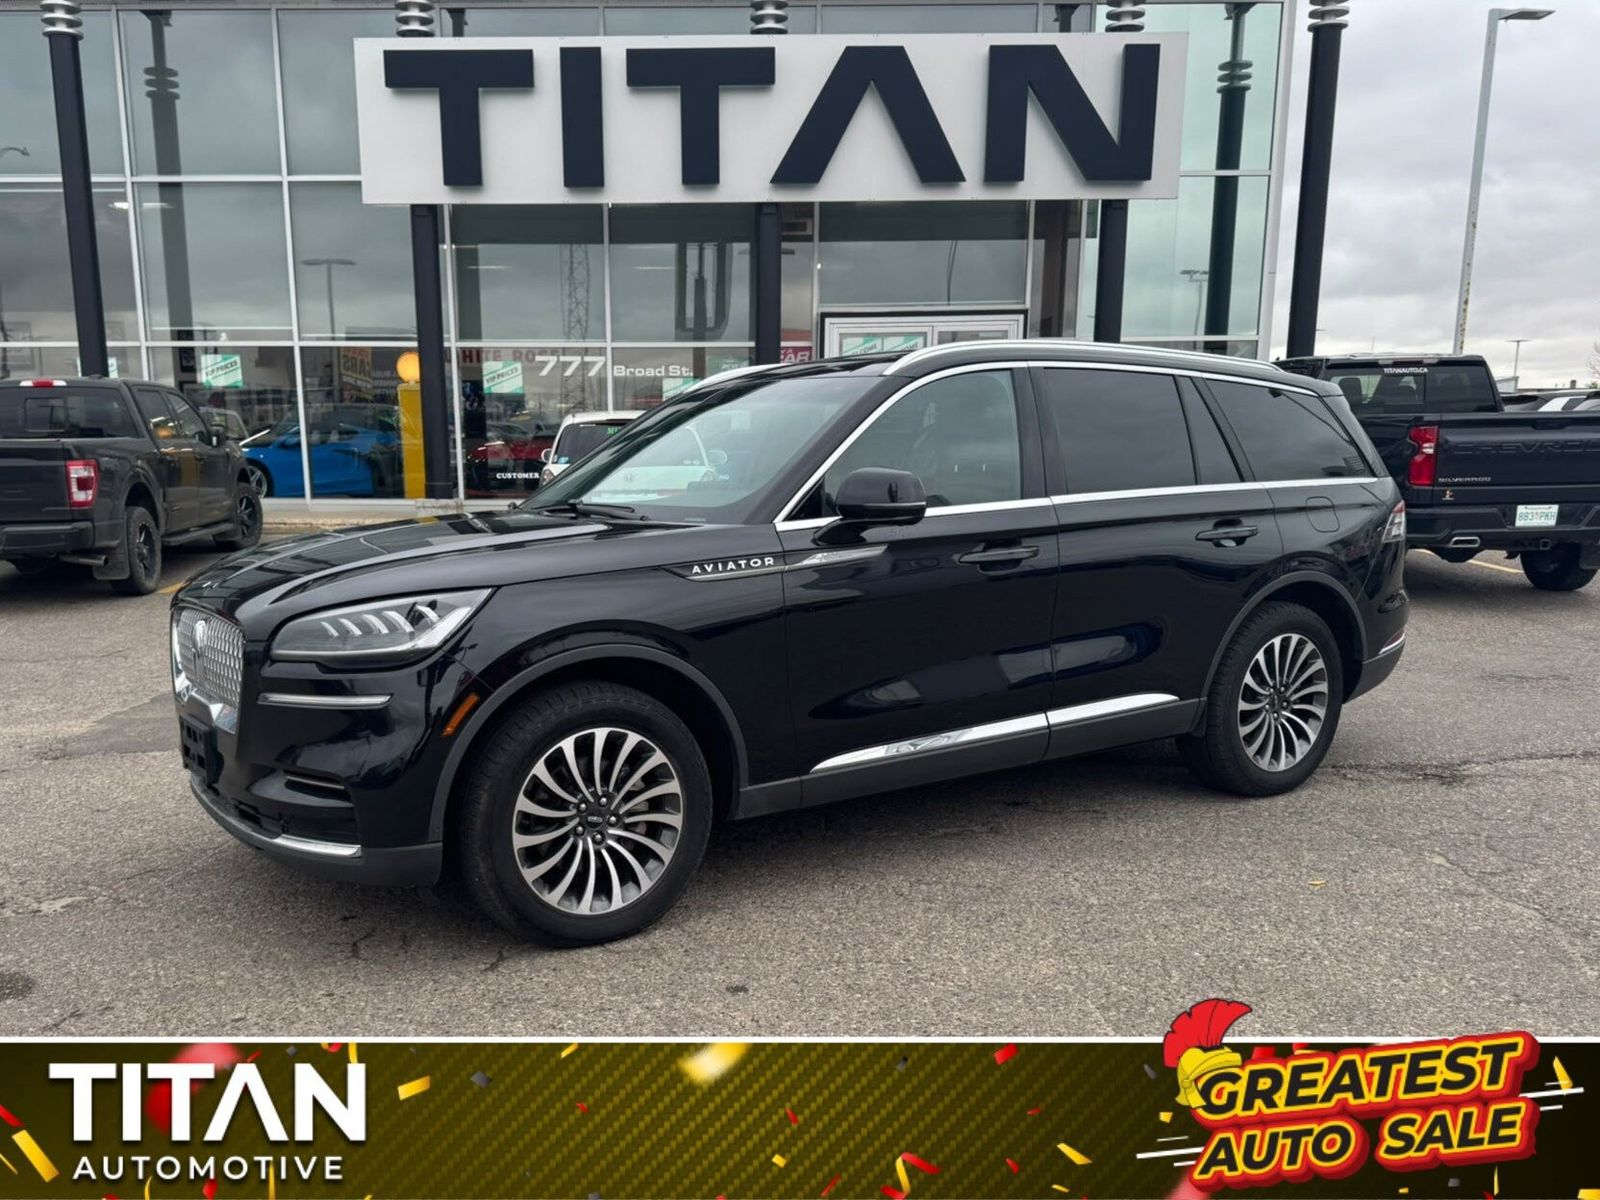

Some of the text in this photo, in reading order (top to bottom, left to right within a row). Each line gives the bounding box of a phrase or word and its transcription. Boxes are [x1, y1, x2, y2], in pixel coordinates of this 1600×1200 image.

[383, 43, 1161, 188] TITAN
[496, 366, 519, 380] PRICES
[534, 355, 694, 377] 777 Broad St.
[495, 472, 540, 480] CUSTOMER
[691, 557, 775, 574] AVIATOR
